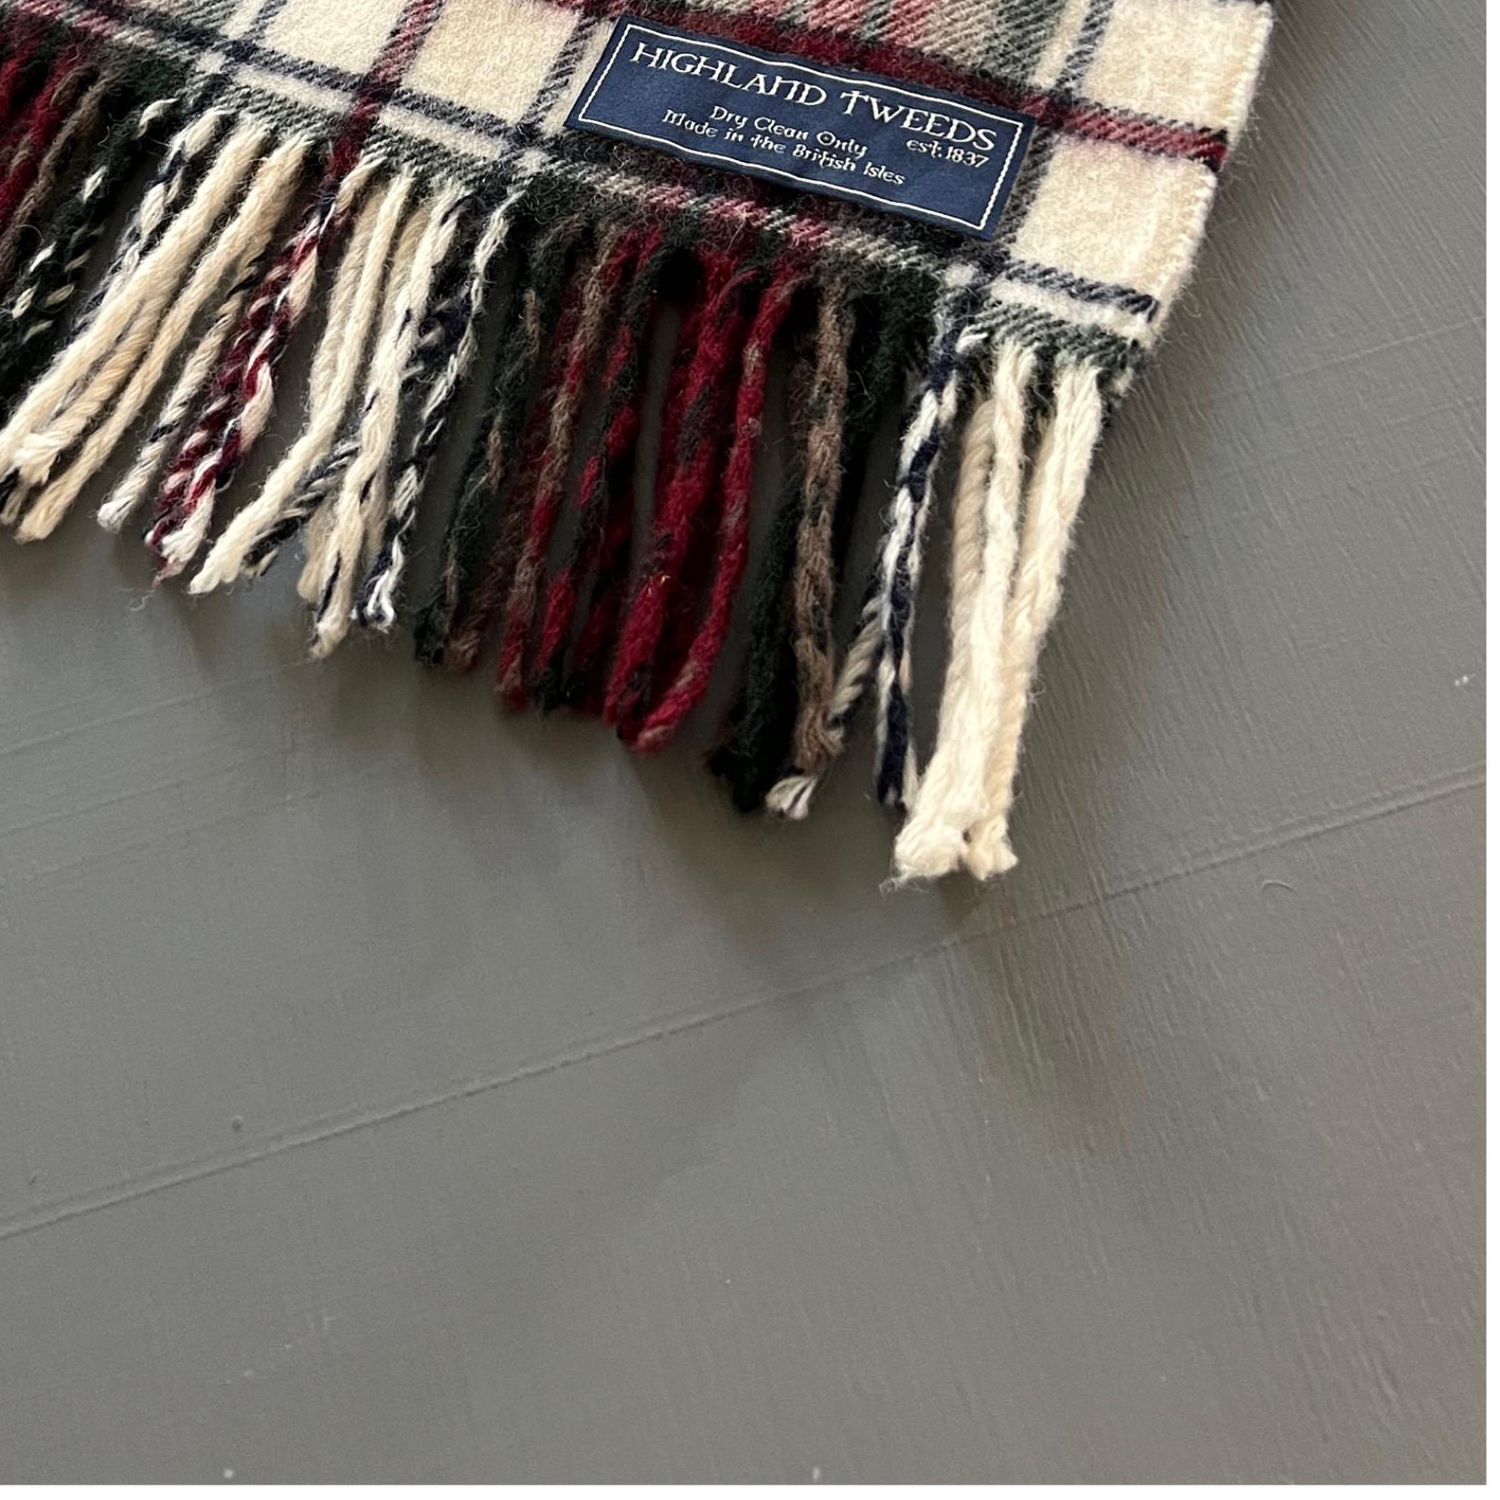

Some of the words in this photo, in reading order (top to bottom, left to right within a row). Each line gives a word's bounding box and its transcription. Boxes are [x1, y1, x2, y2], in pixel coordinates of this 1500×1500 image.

[629, 42, 827, 107] HIGHLAND
[840, 90, 997, 152] TWEEDS
[710, 105, 746, 129] Dry
[754, 116, 809, 141] Clean
[816, 130, 868, 159] Only
[662, 108, 717, 138] Made
[724, 127, 744, 143] in
[751, 133, 786, 155] the
[793, 143, 856, 172] British
[863, 160, 906, 185] Isles
